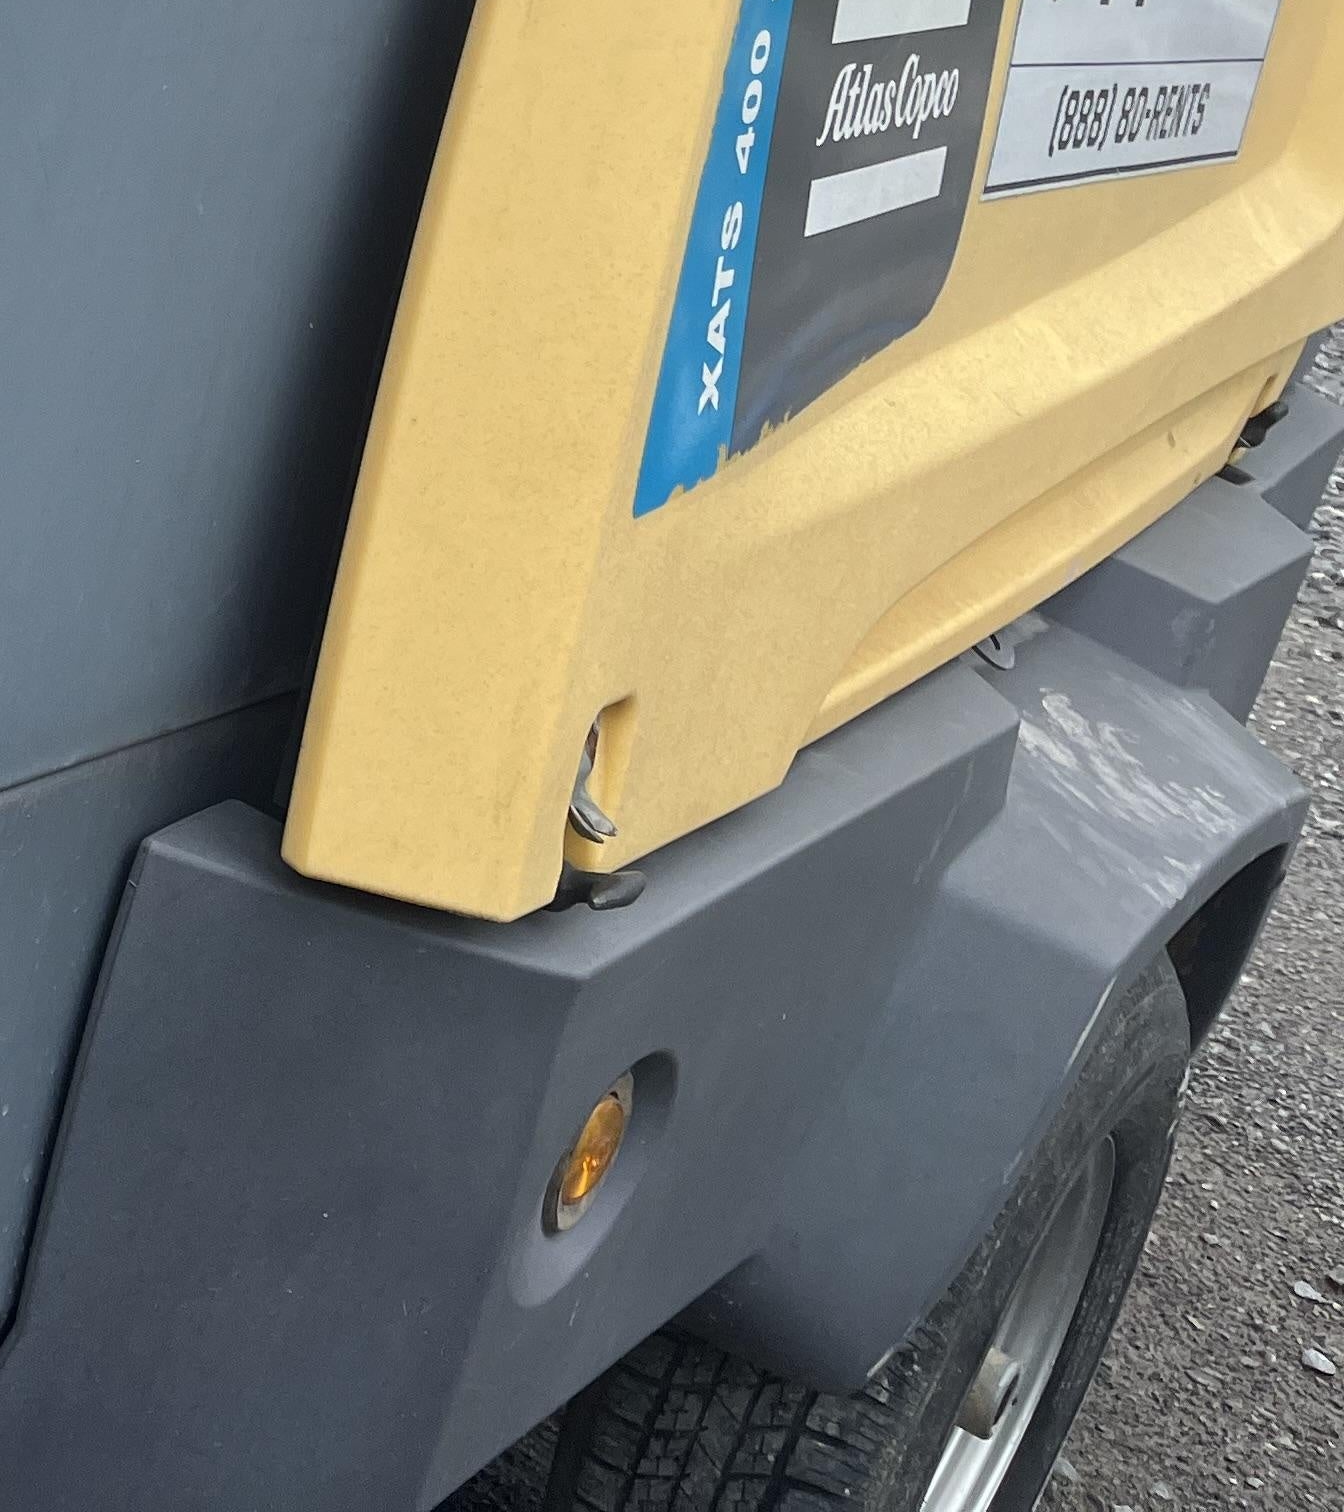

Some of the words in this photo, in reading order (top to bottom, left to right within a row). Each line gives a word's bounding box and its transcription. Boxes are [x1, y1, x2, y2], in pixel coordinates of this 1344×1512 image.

[815, 63, 896, 157] Atlas
[894, 53, 960, 139] Copco
[1048, 83, 1118, 157] (888)
[697, 200, 744, 416] XATS
[734, 29, 771, 175] 400
